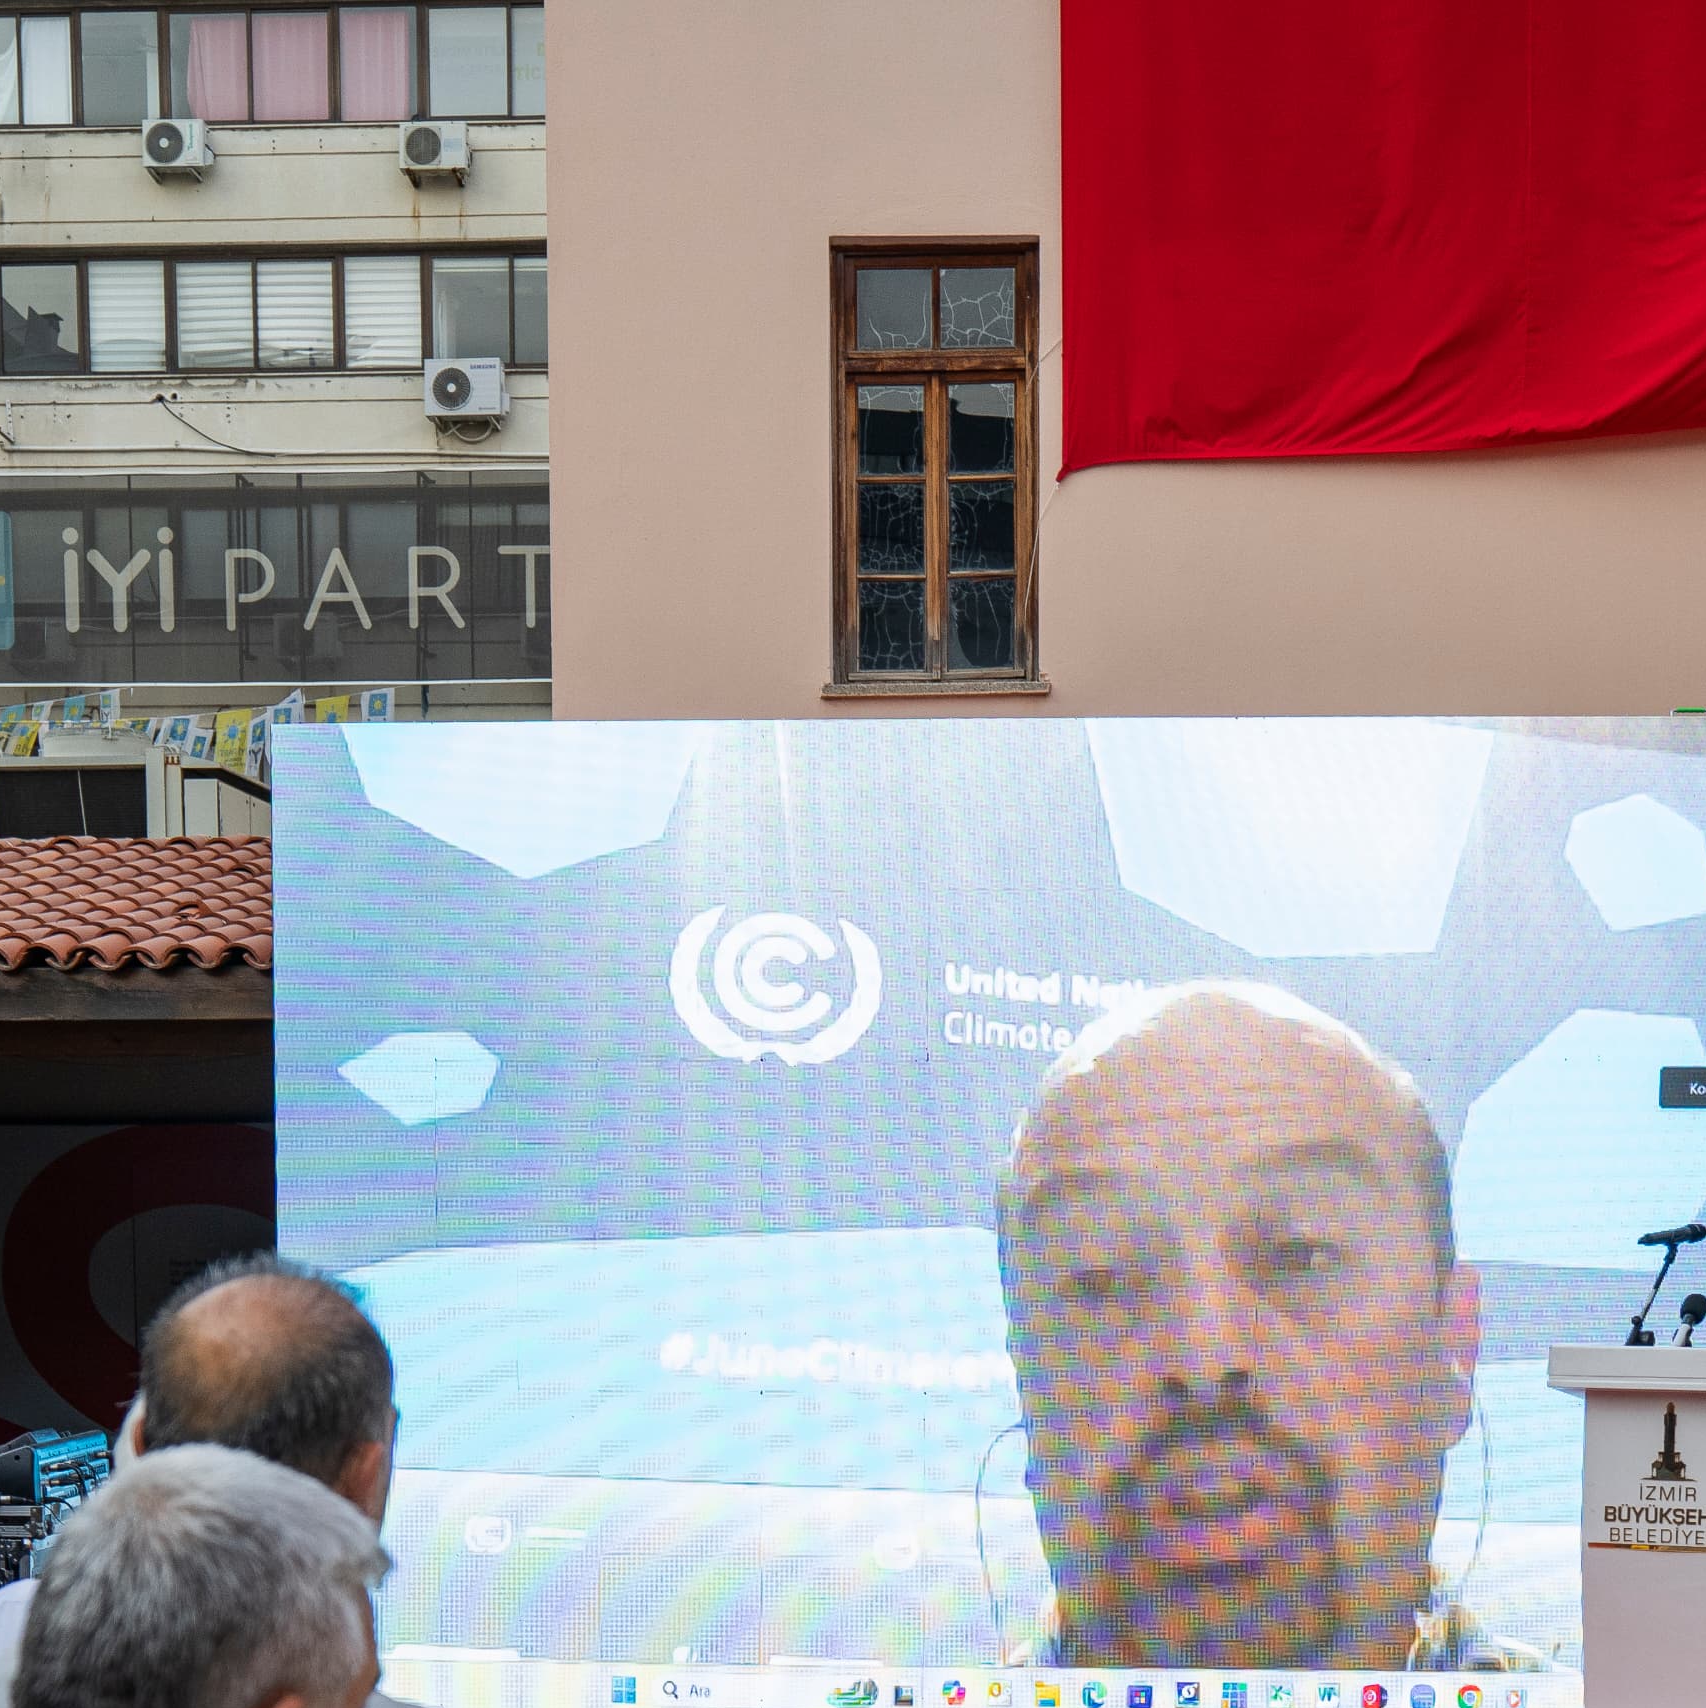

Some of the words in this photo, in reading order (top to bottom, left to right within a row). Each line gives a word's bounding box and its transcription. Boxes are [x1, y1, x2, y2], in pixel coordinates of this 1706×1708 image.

[62, 526, 175, 633] İYİ
[944, 962, 1061, 1003] United
[1639, 1483, 1698, 1502] İZMİR
[689, 1683, 711, 1698] Ara
